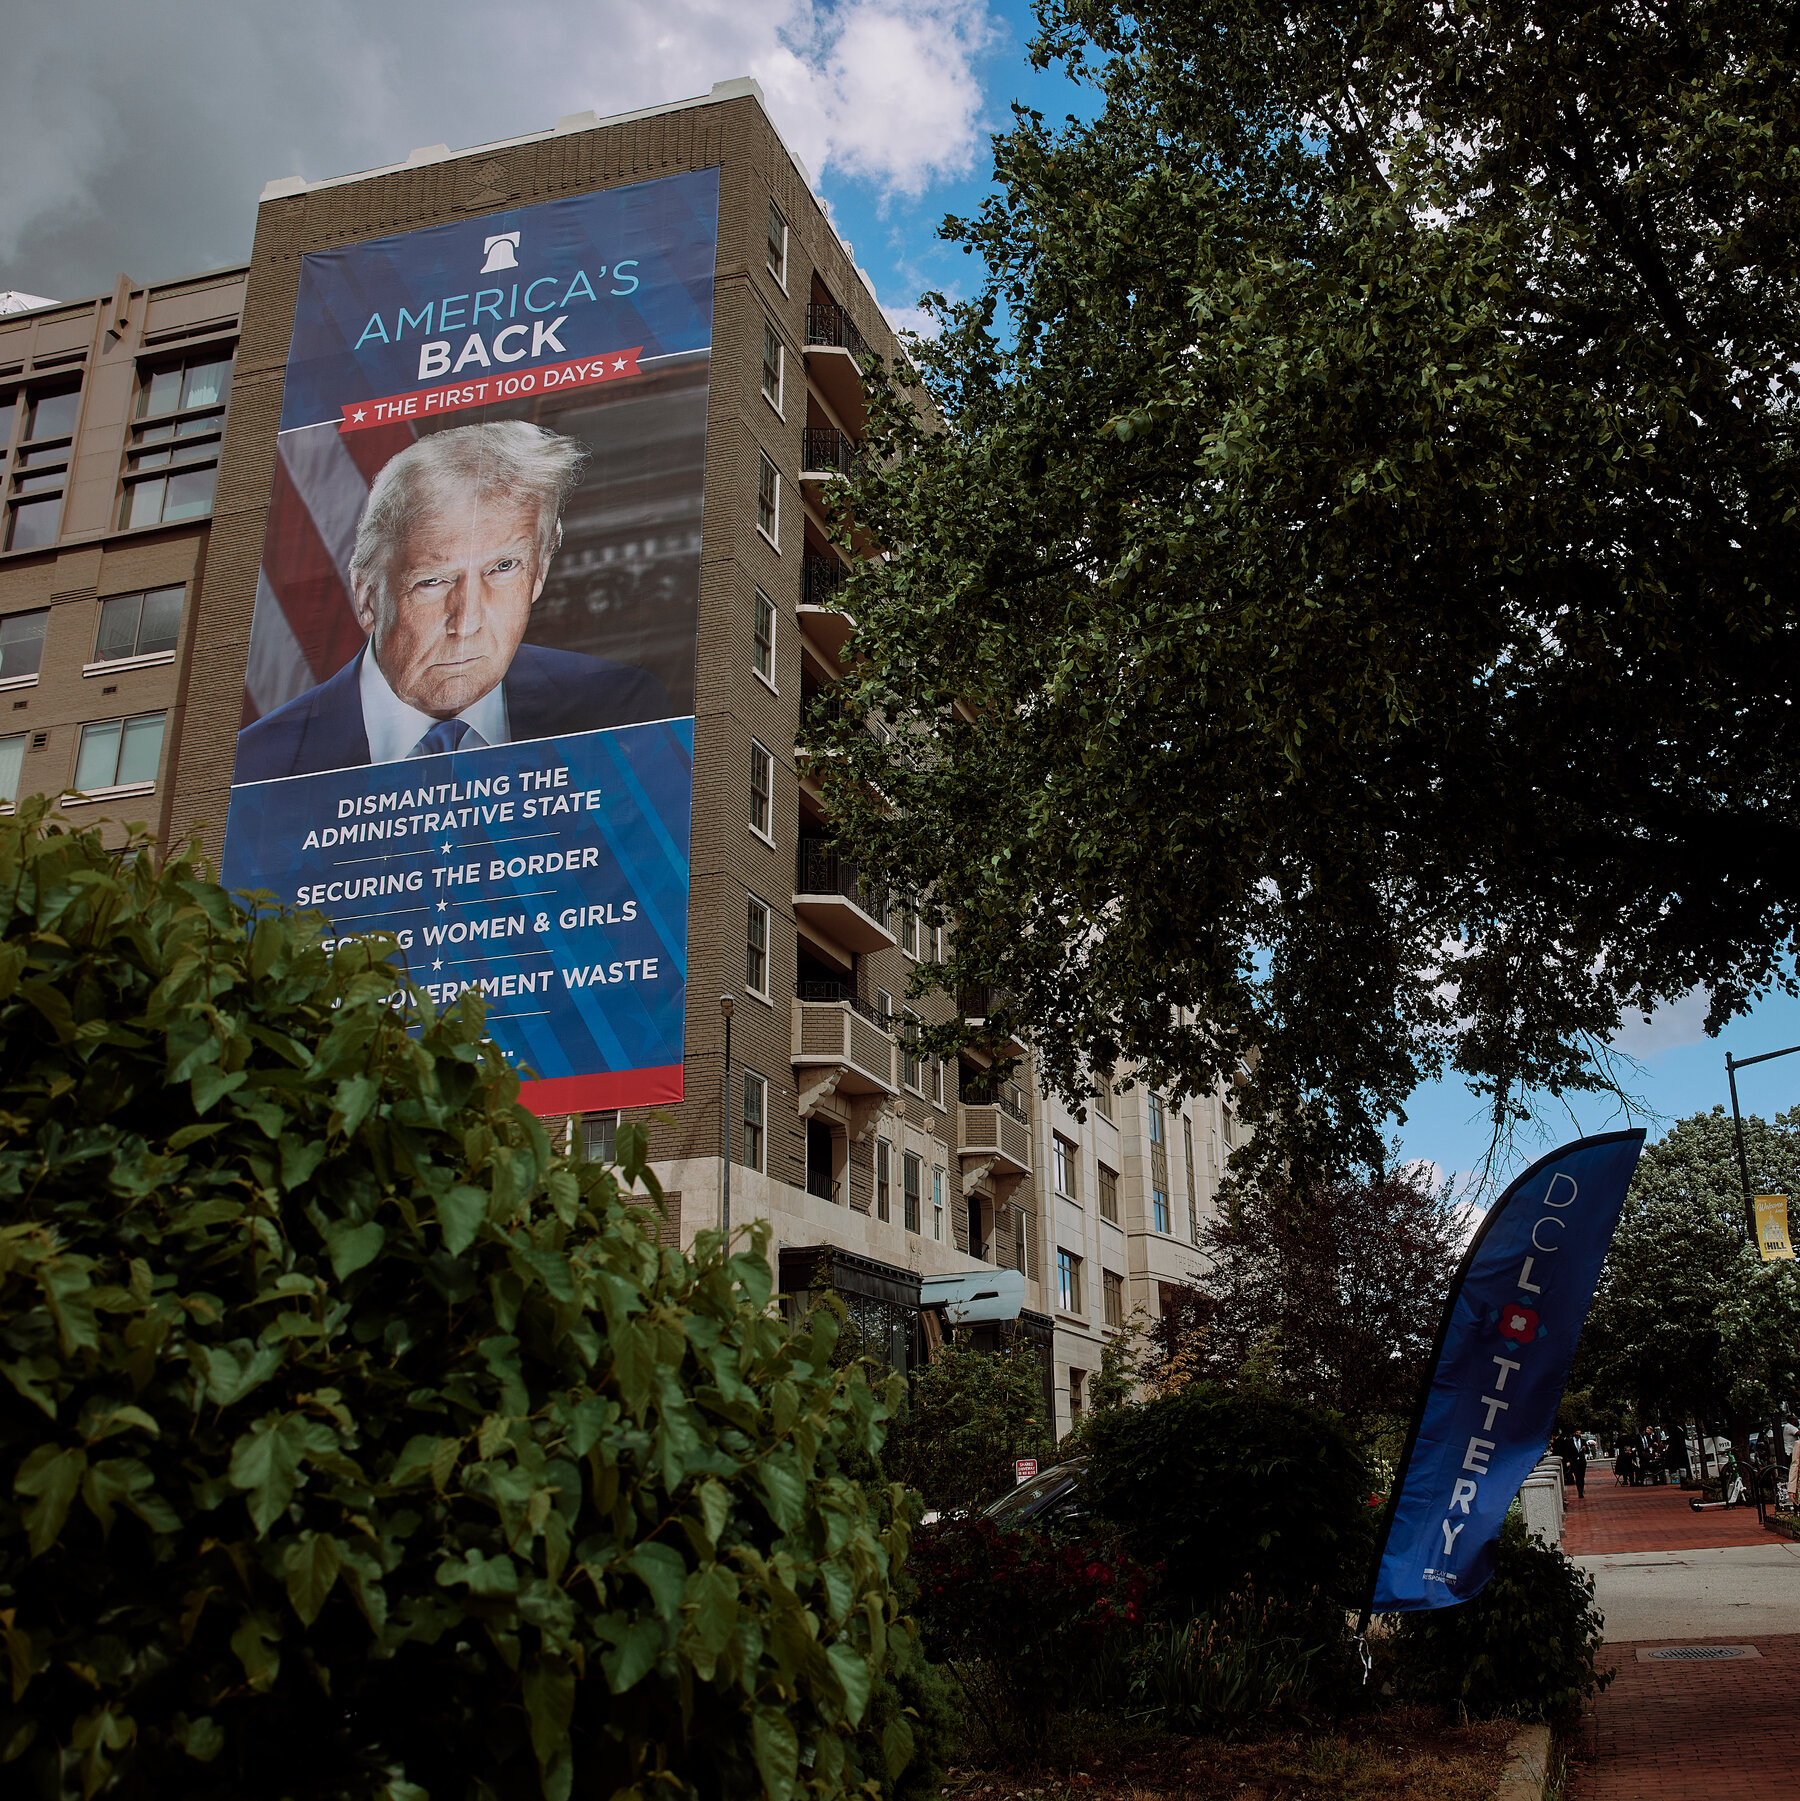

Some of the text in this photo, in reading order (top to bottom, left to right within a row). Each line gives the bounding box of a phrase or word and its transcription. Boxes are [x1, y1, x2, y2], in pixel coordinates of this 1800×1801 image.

[354, 259, 640, 350] AMERICA'S
[417, 314, 569, 381] BACK
[373, 360, 604, 421] THE FIRST 100 DAYS
[301, 789, 602, 851] ADMINISTRATIVE STATE
[337, 766, 569, 819] DISMANTLING THE
[295, 847, 599, 907] SECURING THE BORDER
[422, 914, 525, 947] WOMEN
[533, 912, 551, 933] &
[559, 900, 638, 930] GIRLS
[562, 957, 659, 989] WASTE
